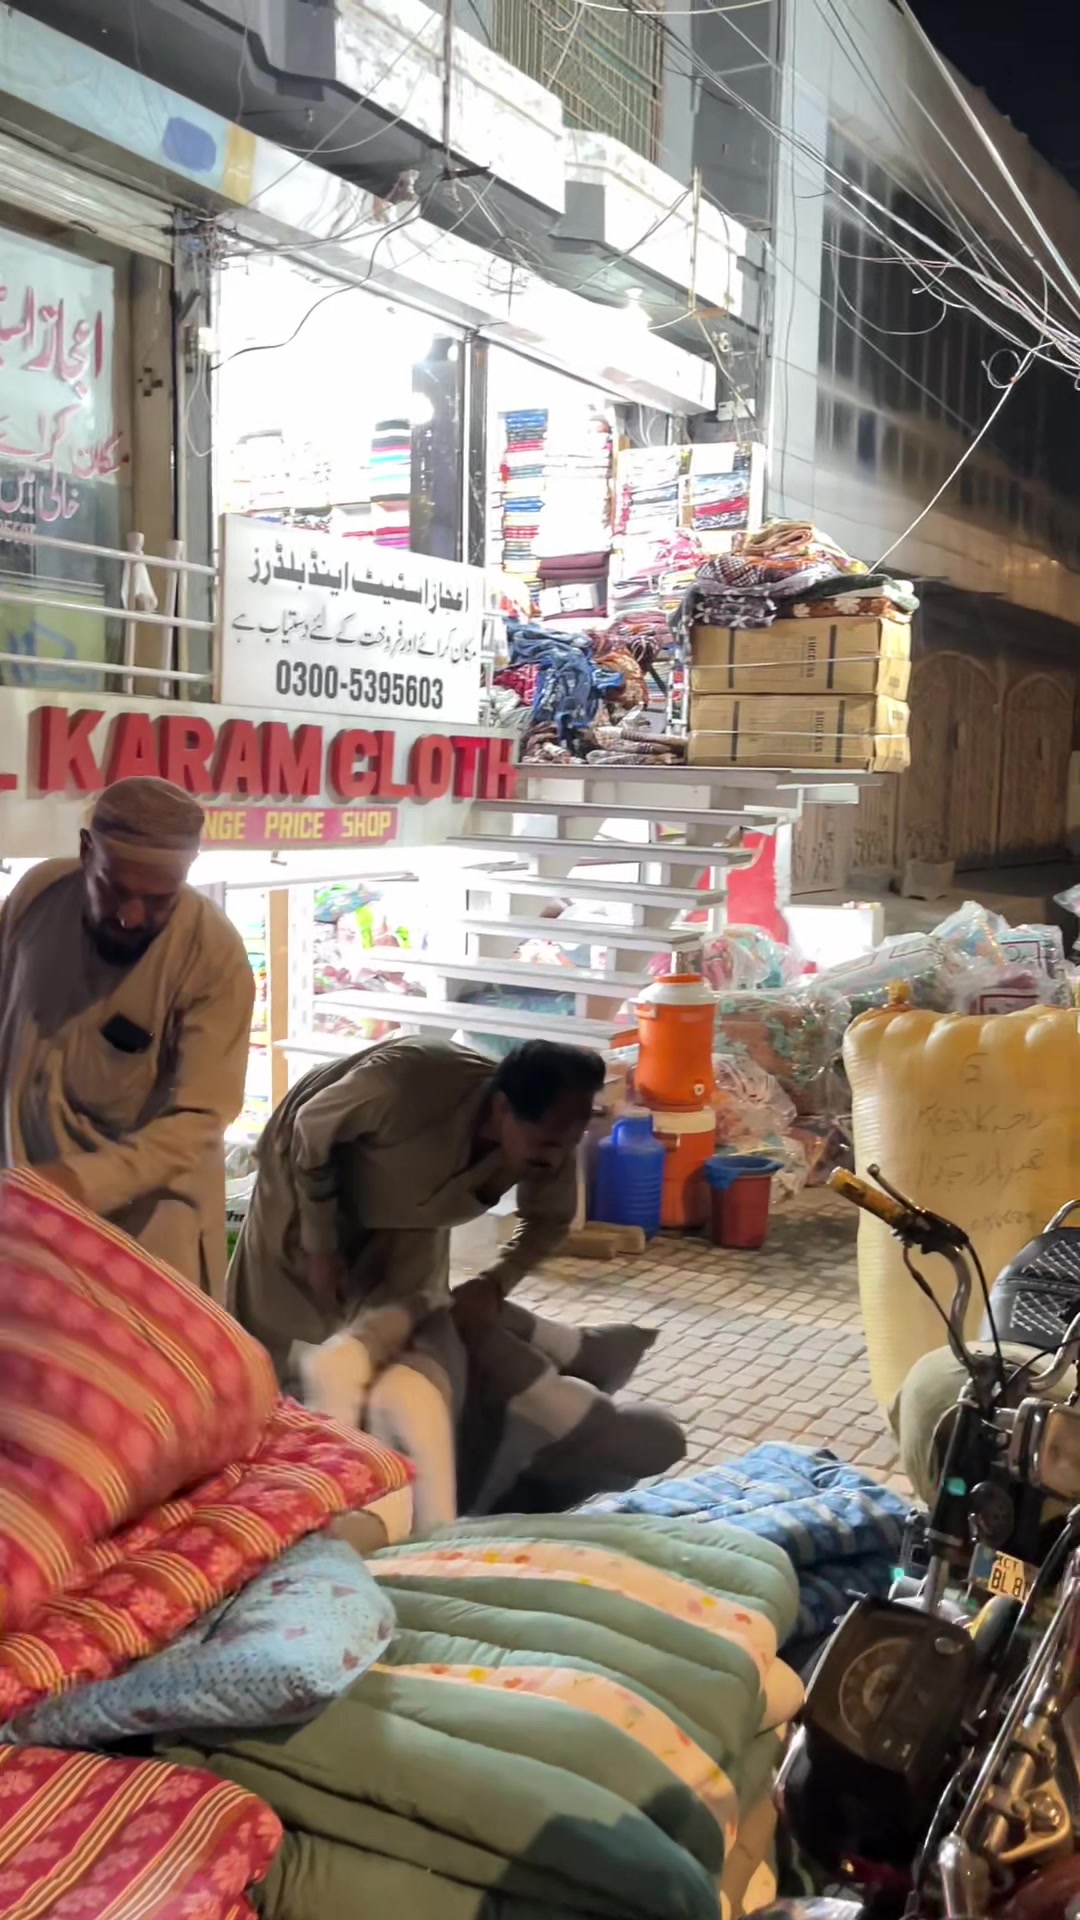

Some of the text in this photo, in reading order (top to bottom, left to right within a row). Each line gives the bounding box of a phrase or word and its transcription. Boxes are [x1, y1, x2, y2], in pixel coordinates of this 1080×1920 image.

[37, 462, 80, 522] خالی
[231, 613, 256, 644] ہے
[276, 659, 444, 710] 0300-5395603
[38, 706, 518, 799] KARAM CLOTH
[264, 810, 325, 840] PRICE
[339, 809, 392, 838] SHOP
